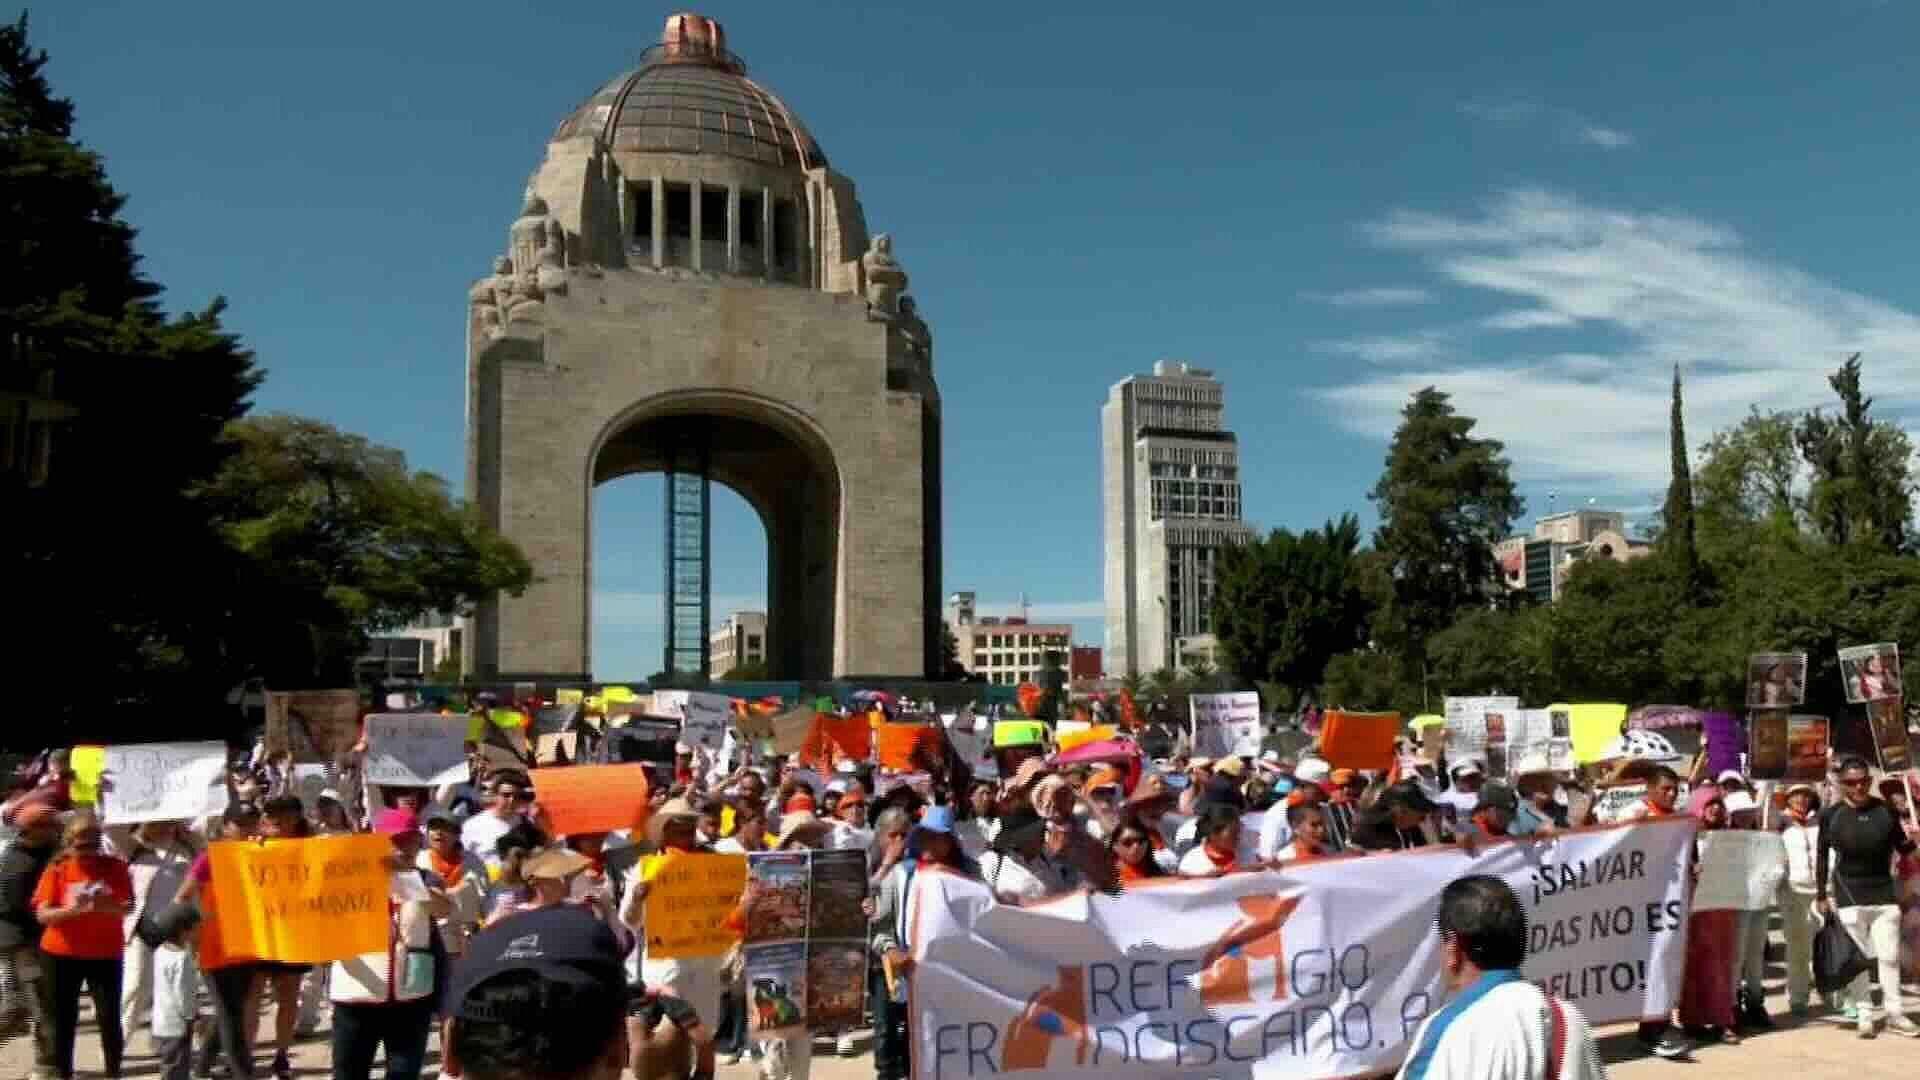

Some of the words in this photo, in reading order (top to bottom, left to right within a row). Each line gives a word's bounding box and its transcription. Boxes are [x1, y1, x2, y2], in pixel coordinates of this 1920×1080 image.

[1531, 850, 1646, 904] ¡SALVAR
[1530, 914, 1582, 953] DAS
[1590, 905, 1634, 940] NO
[1646, 900, 1681, 933] ES
[1543, 960, 1647, 1000] ELITO!
